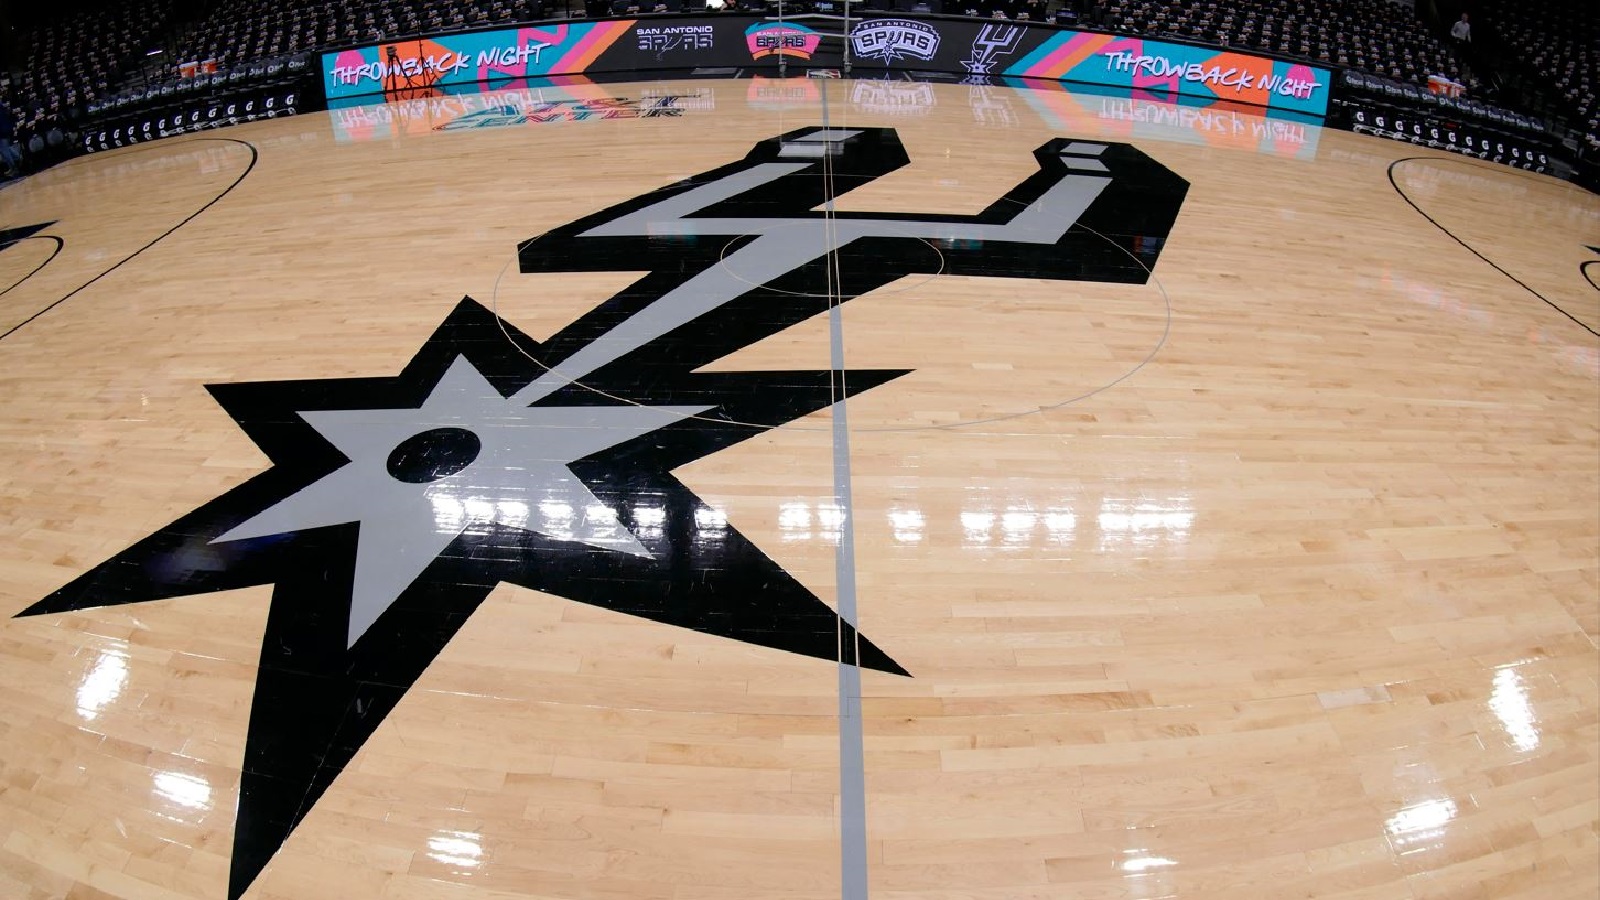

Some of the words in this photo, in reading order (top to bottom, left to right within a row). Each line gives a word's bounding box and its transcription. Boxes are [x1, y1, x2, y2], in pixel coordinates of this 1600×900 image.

[663, 26, 713, 34] ANTONIO
[886, 21, 929, 32] ANTONIO
[861, 31, 930, 51] SPURS
[330, 53, 471, 87] THROWBACK
[477, 43, 552, 67] NIGHT
[1105, 52, 1253, 91] THROWBACK
[1258, 74, 1322, 99] NIGHT
